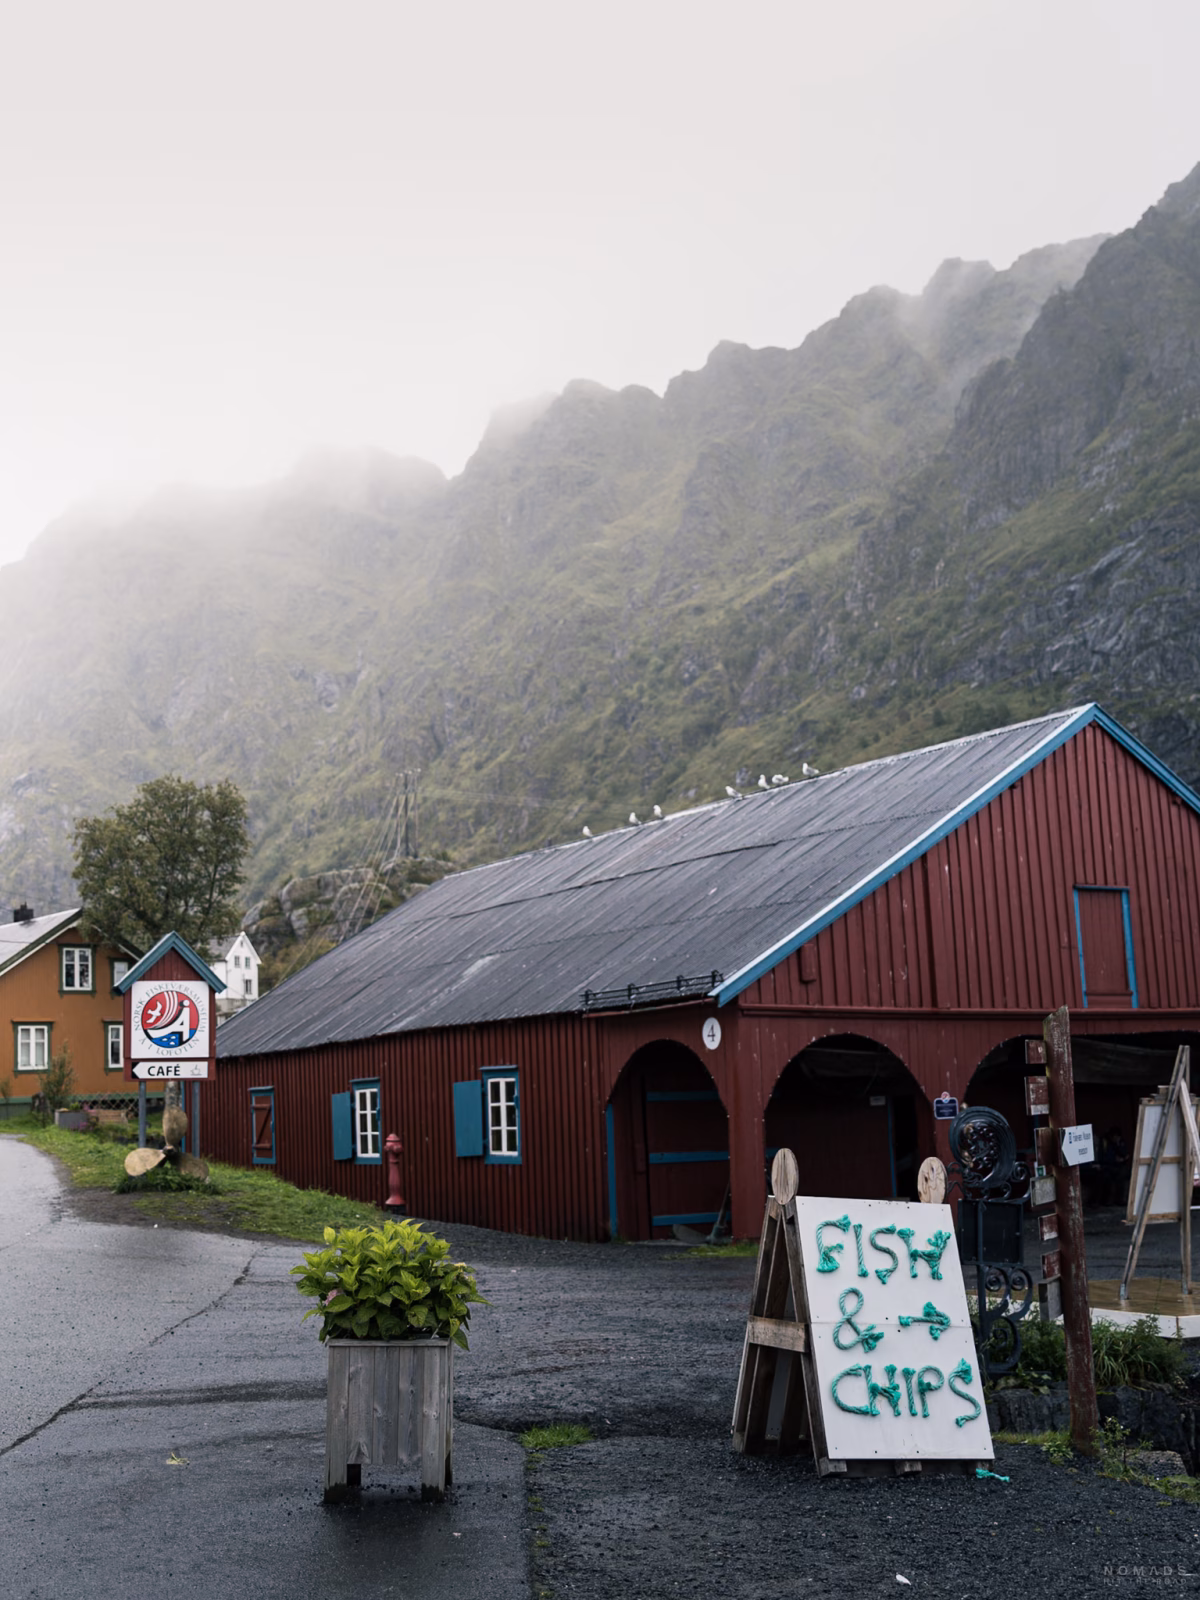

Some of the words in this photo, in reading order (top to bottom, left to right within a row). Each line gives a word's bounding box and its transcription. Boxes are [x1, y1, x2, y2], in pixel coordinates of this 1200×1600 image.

[133, 998, 146, 1031] NORSK
[156, 1037, 200, 1056] LOFOTEN
[707, 1023, 716, 1042] 4
[147, 1064, 181, 1077] CAFÉ
[815, 1214, 952, 1285] FISH
[832, 1287, 885, 1353] &
[831, 1358, 982, 1428] CHIPS
